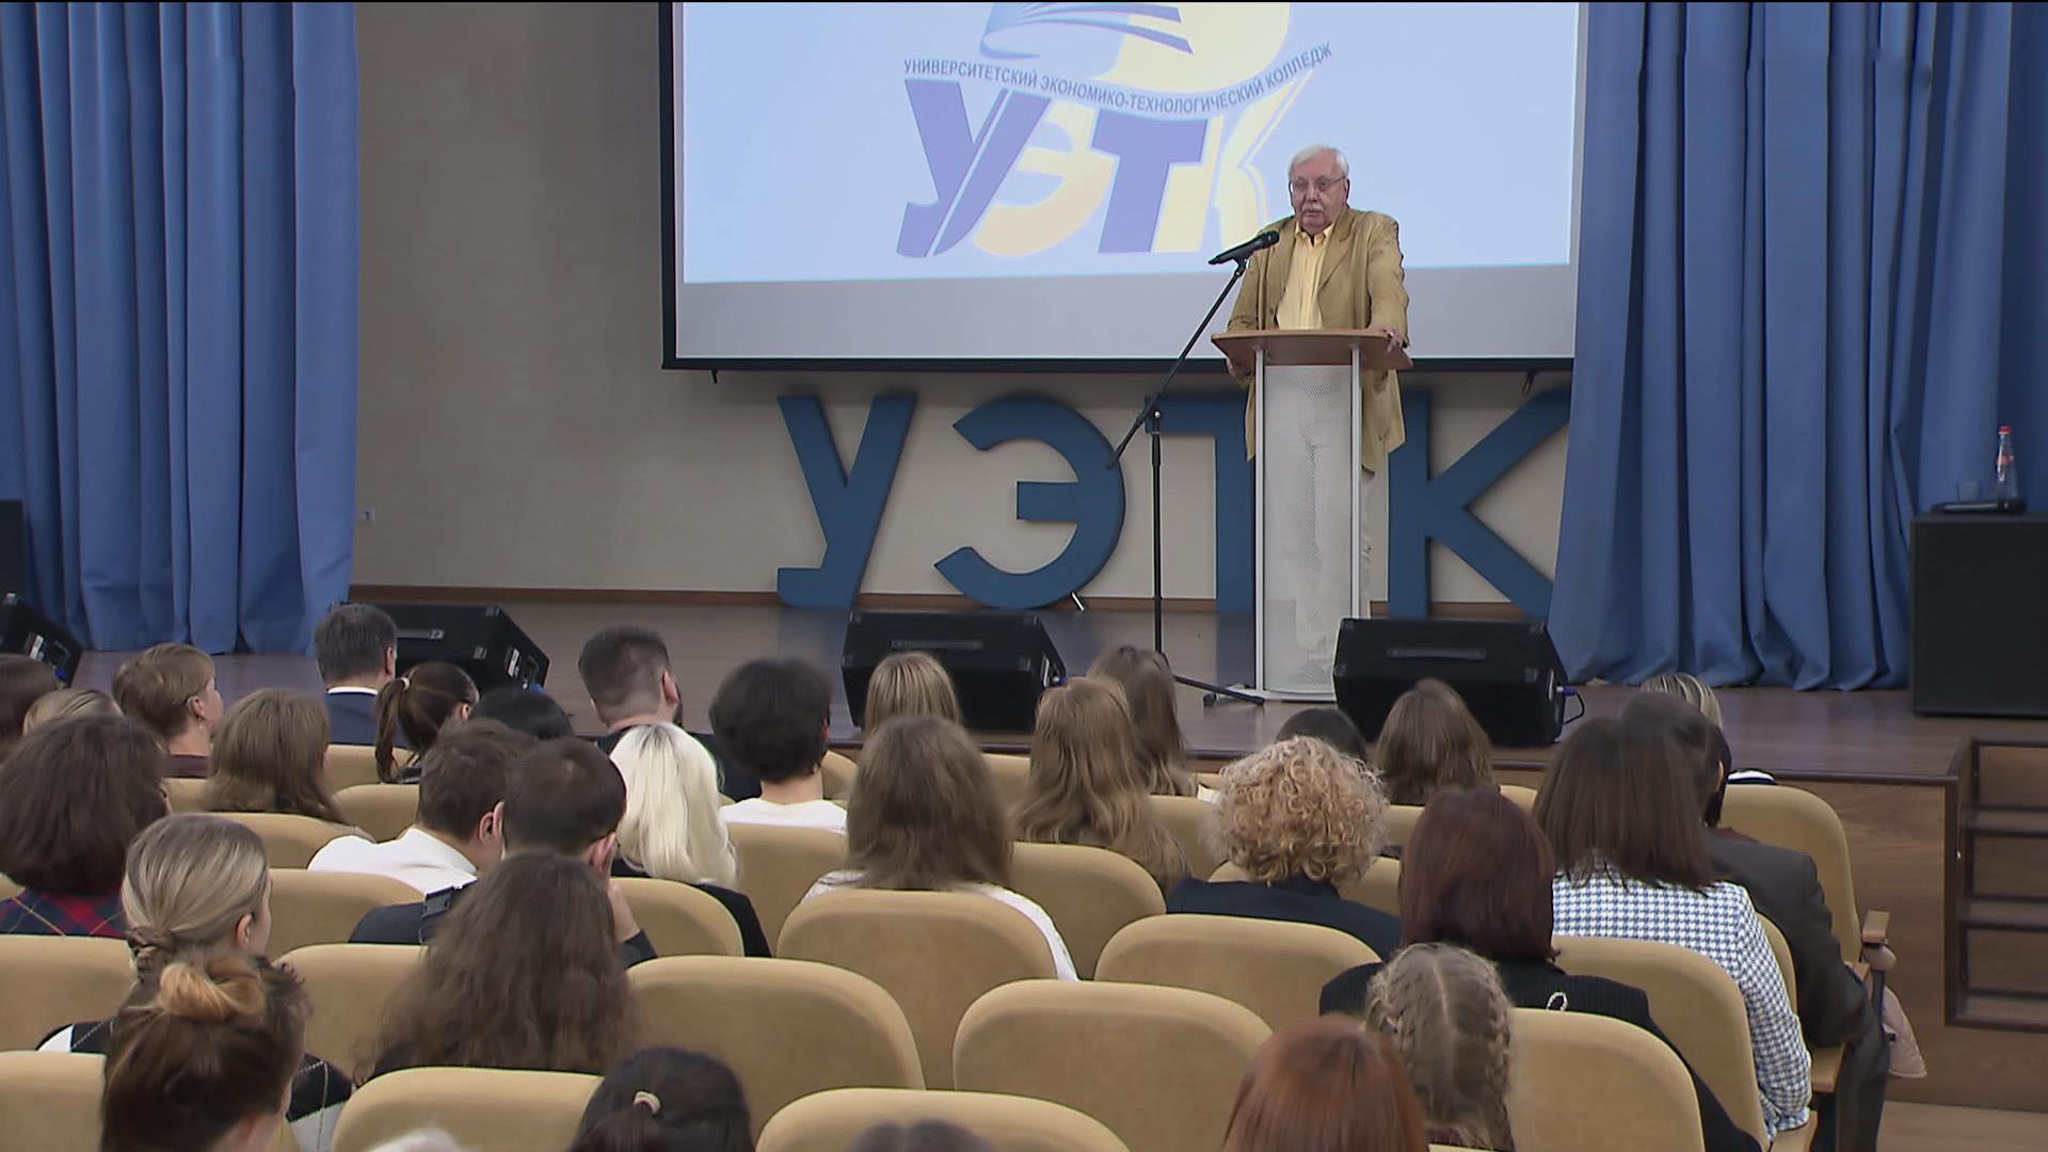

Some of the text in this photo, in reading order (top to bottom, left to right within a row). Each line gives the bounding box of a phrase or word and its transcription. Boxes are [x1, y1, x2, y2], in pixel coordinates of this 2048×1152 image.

[904, 41, 1332, 114] УНИВЕРСИТЕТСКИЙ ЭКОНОМИКО-ТЕХНОЛОГИЧЕСКИЙ КОЛЛЕДЖ
